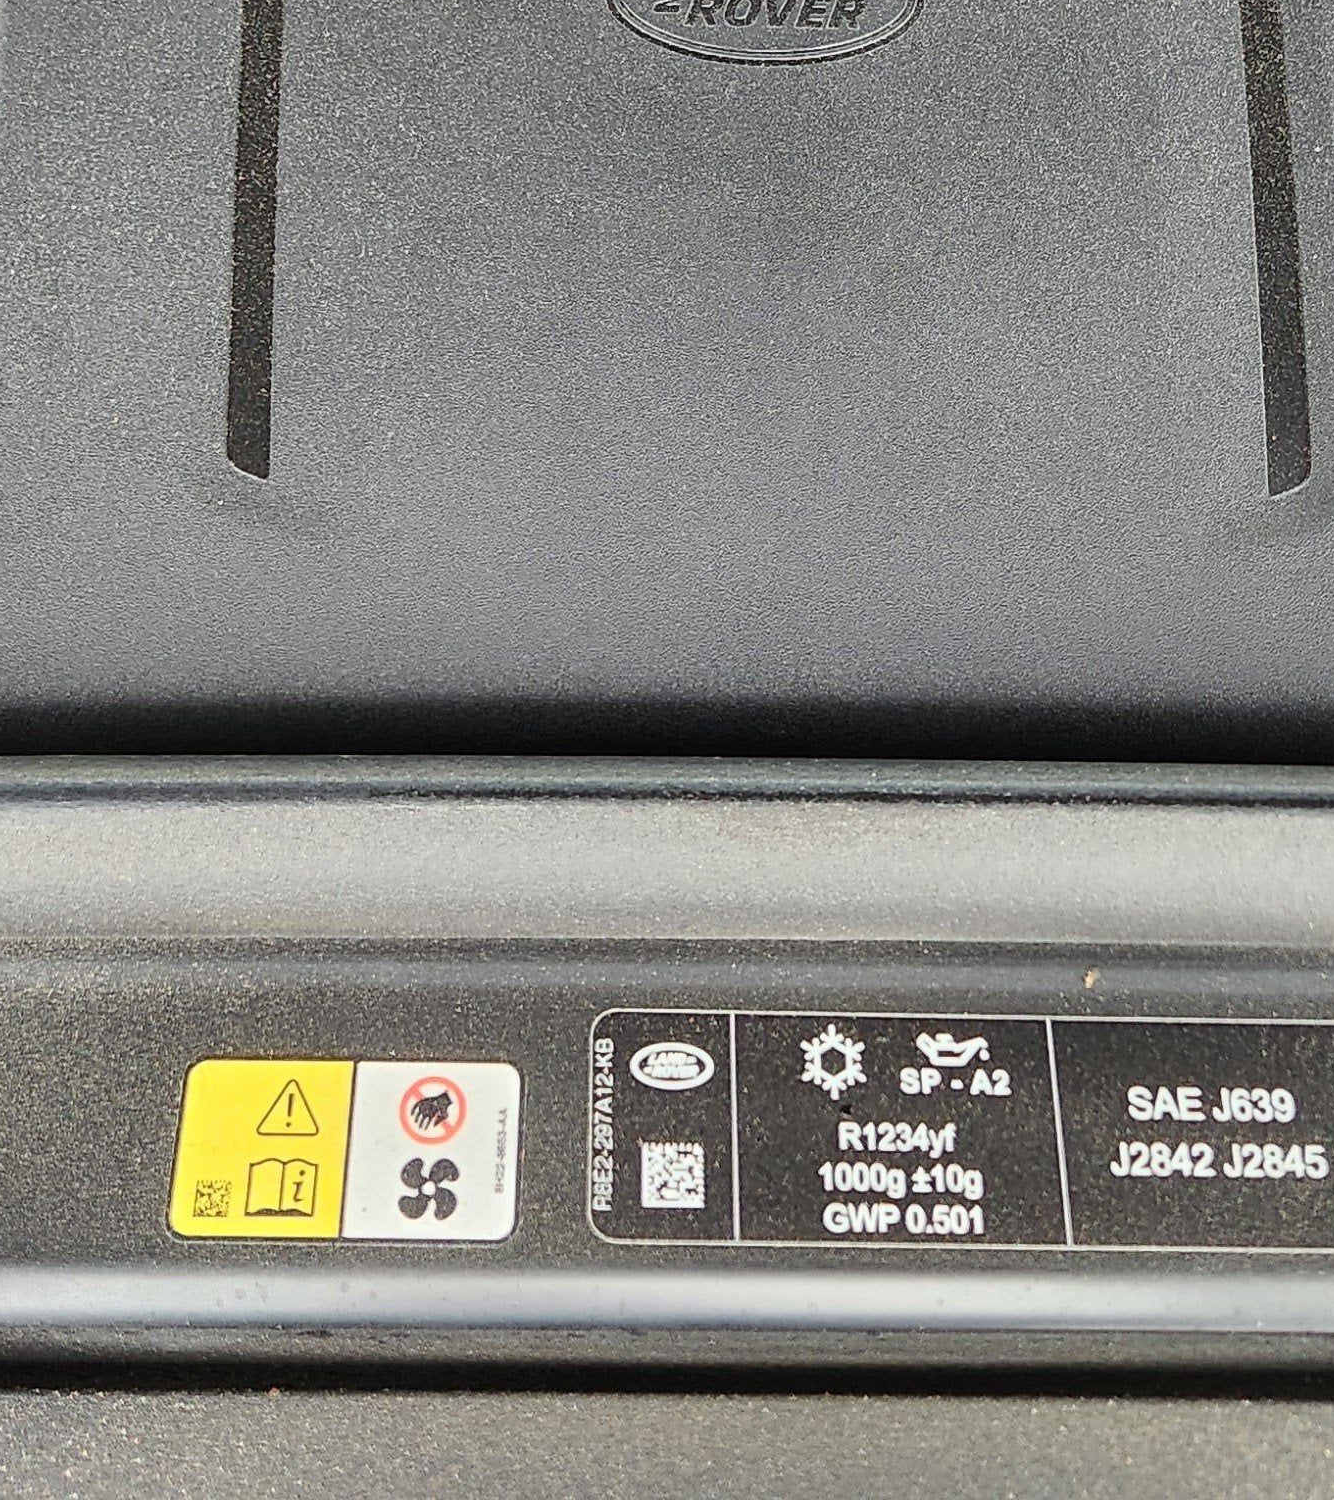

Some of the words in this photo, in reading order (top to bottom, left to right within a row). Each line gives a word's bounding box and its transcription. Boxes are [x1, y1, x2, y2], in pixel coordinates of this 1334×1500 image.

[899, 1066, 943, 1095] SP
[969, 1068, 1012, 1096] A2
[1127, 1085, 1207, 1122] SAE
[1212, 1086, 1298, 1124] J639
[837, 1121, 958, 1159] R1234yf
[1109, 1140, 1217, 1178] J2842
[1222, 1142, 1330, 1179] J2845
[817, 1161, 907, 1199] 1000g
[910, 1162, 985, 1200] ±10g
[822, 1201, 902, 1234] GWP
[904, 1202, 985, 1235] 0.501
